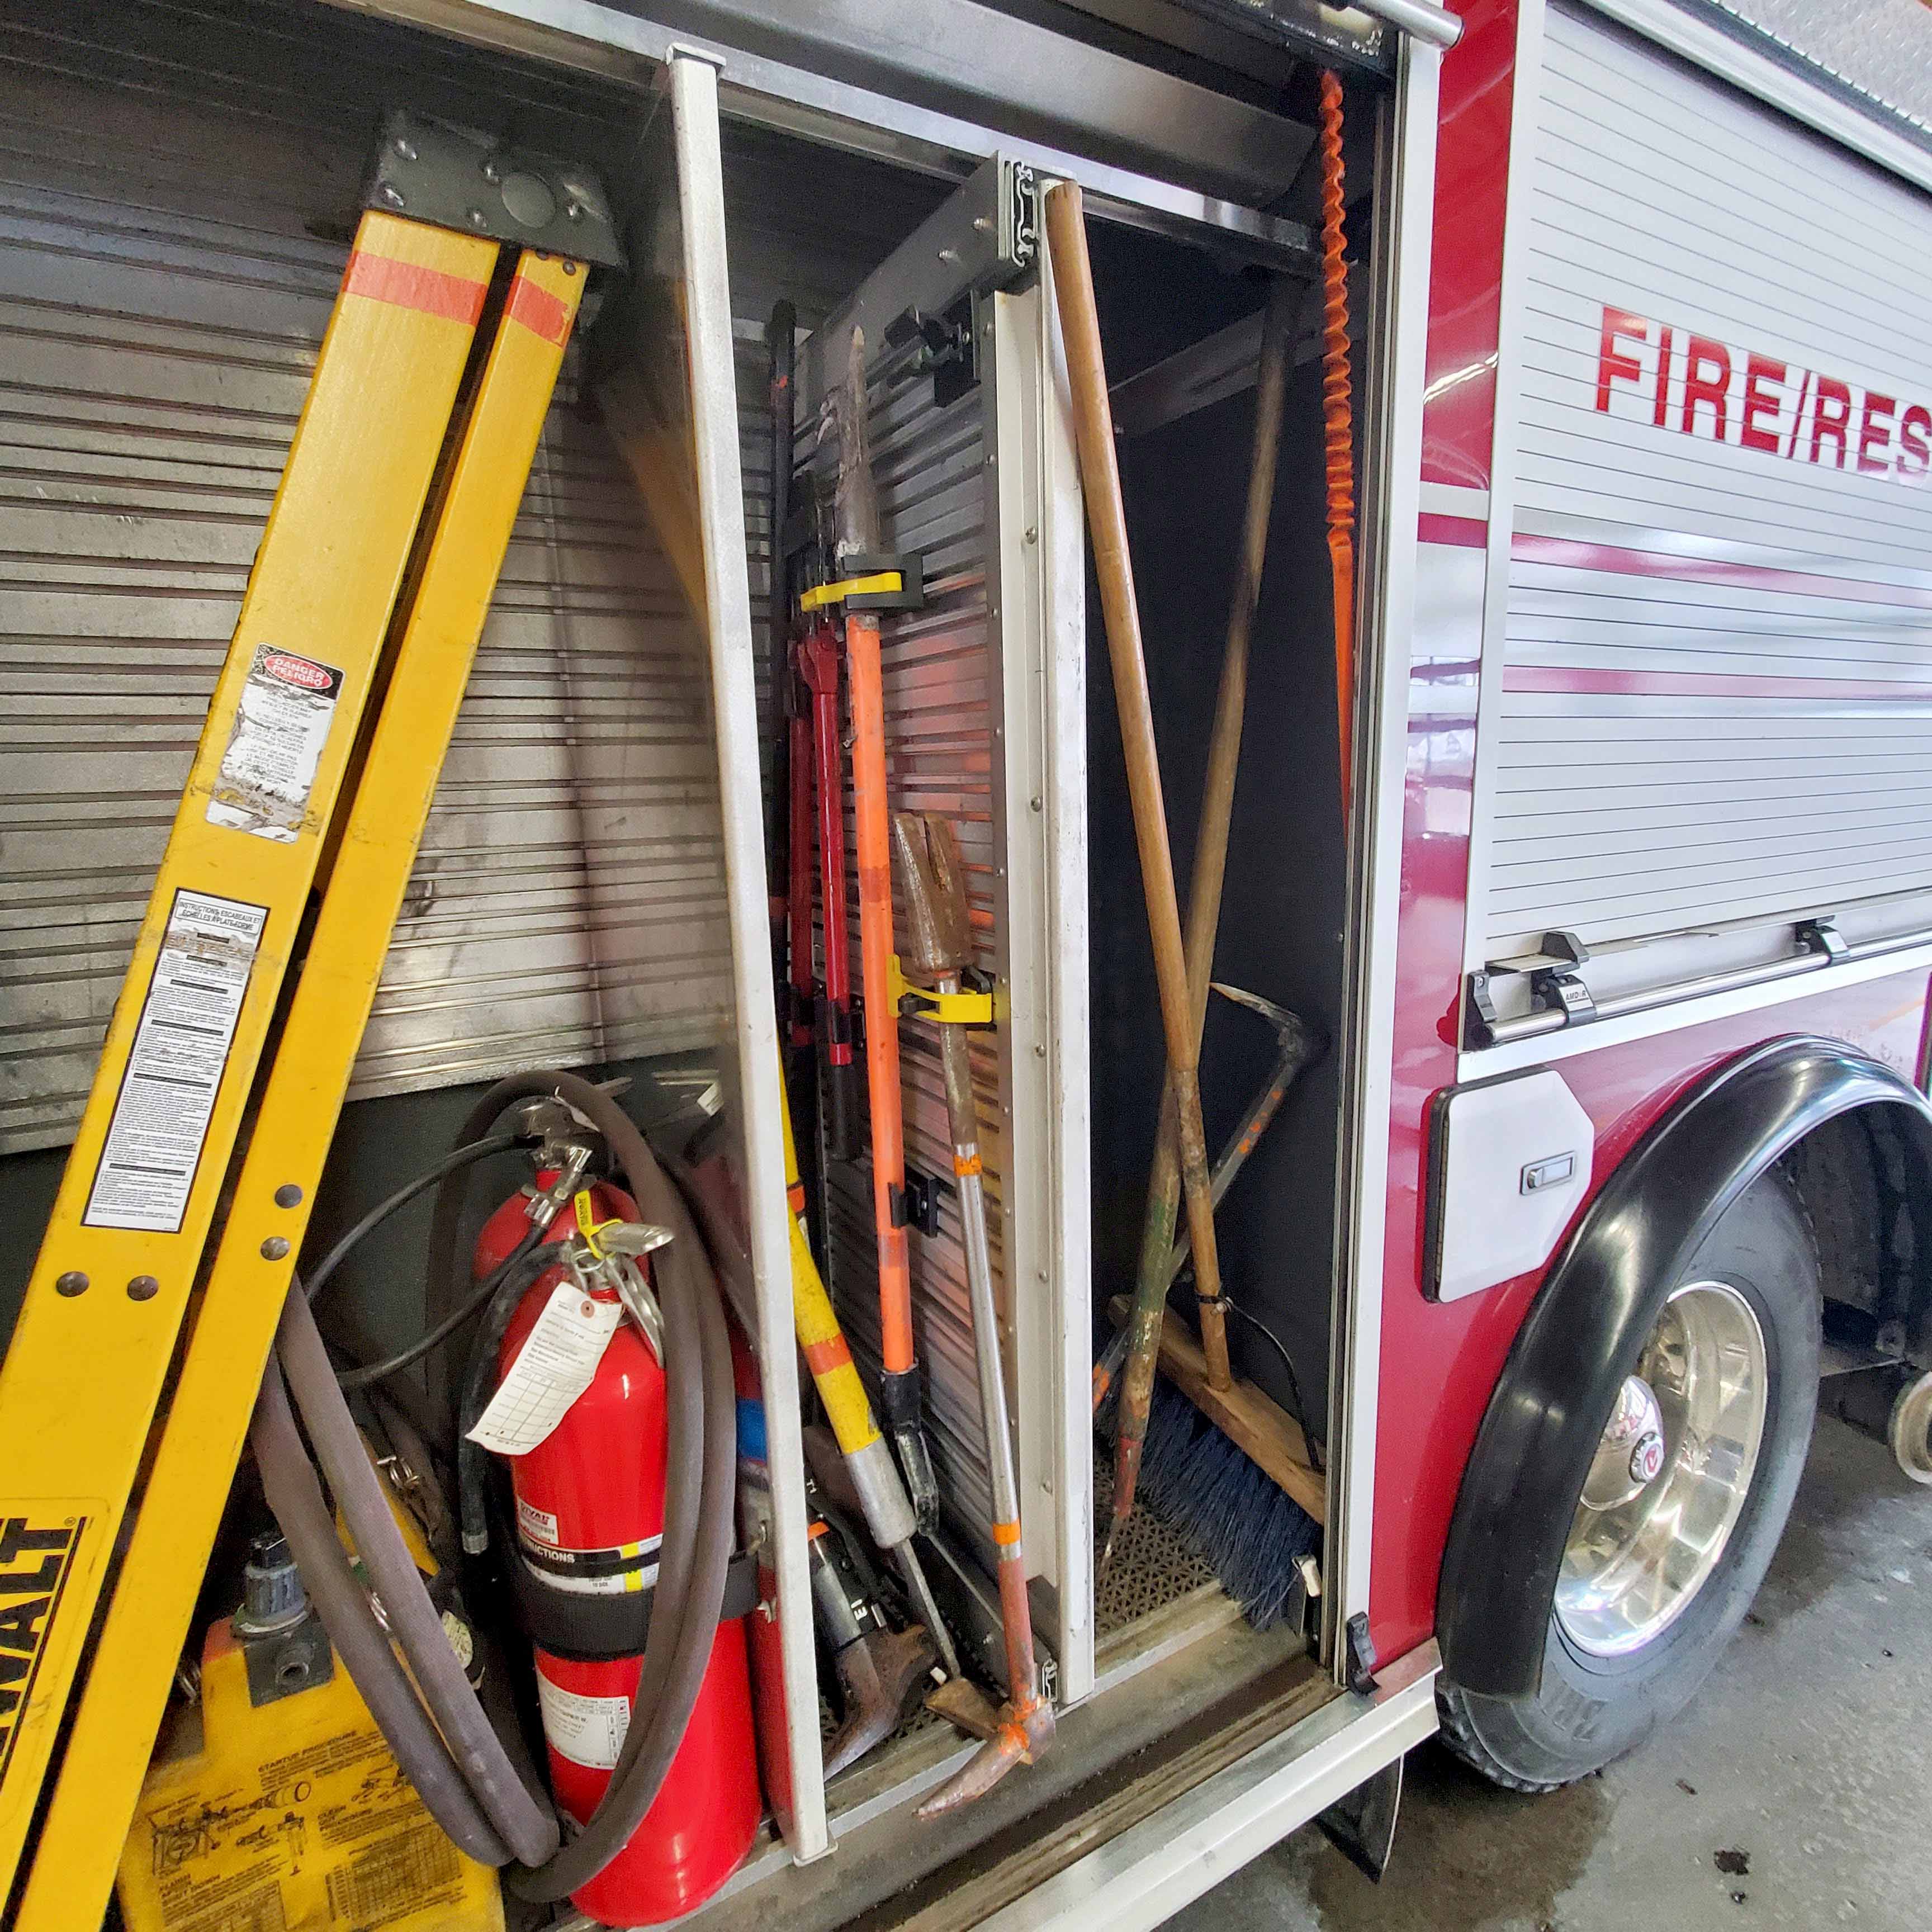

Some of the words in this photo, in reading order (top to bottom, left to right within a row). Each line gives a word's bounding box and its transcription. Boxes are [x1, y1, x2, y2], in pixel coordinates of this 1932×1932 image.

[1595, 306, 1932, 486] FIRE/RES
[272, 664, 323, 687] PELIGRO
[274, 659, 325, 680] DANGER
[1566, 989, 1586, 1000] AMDR
